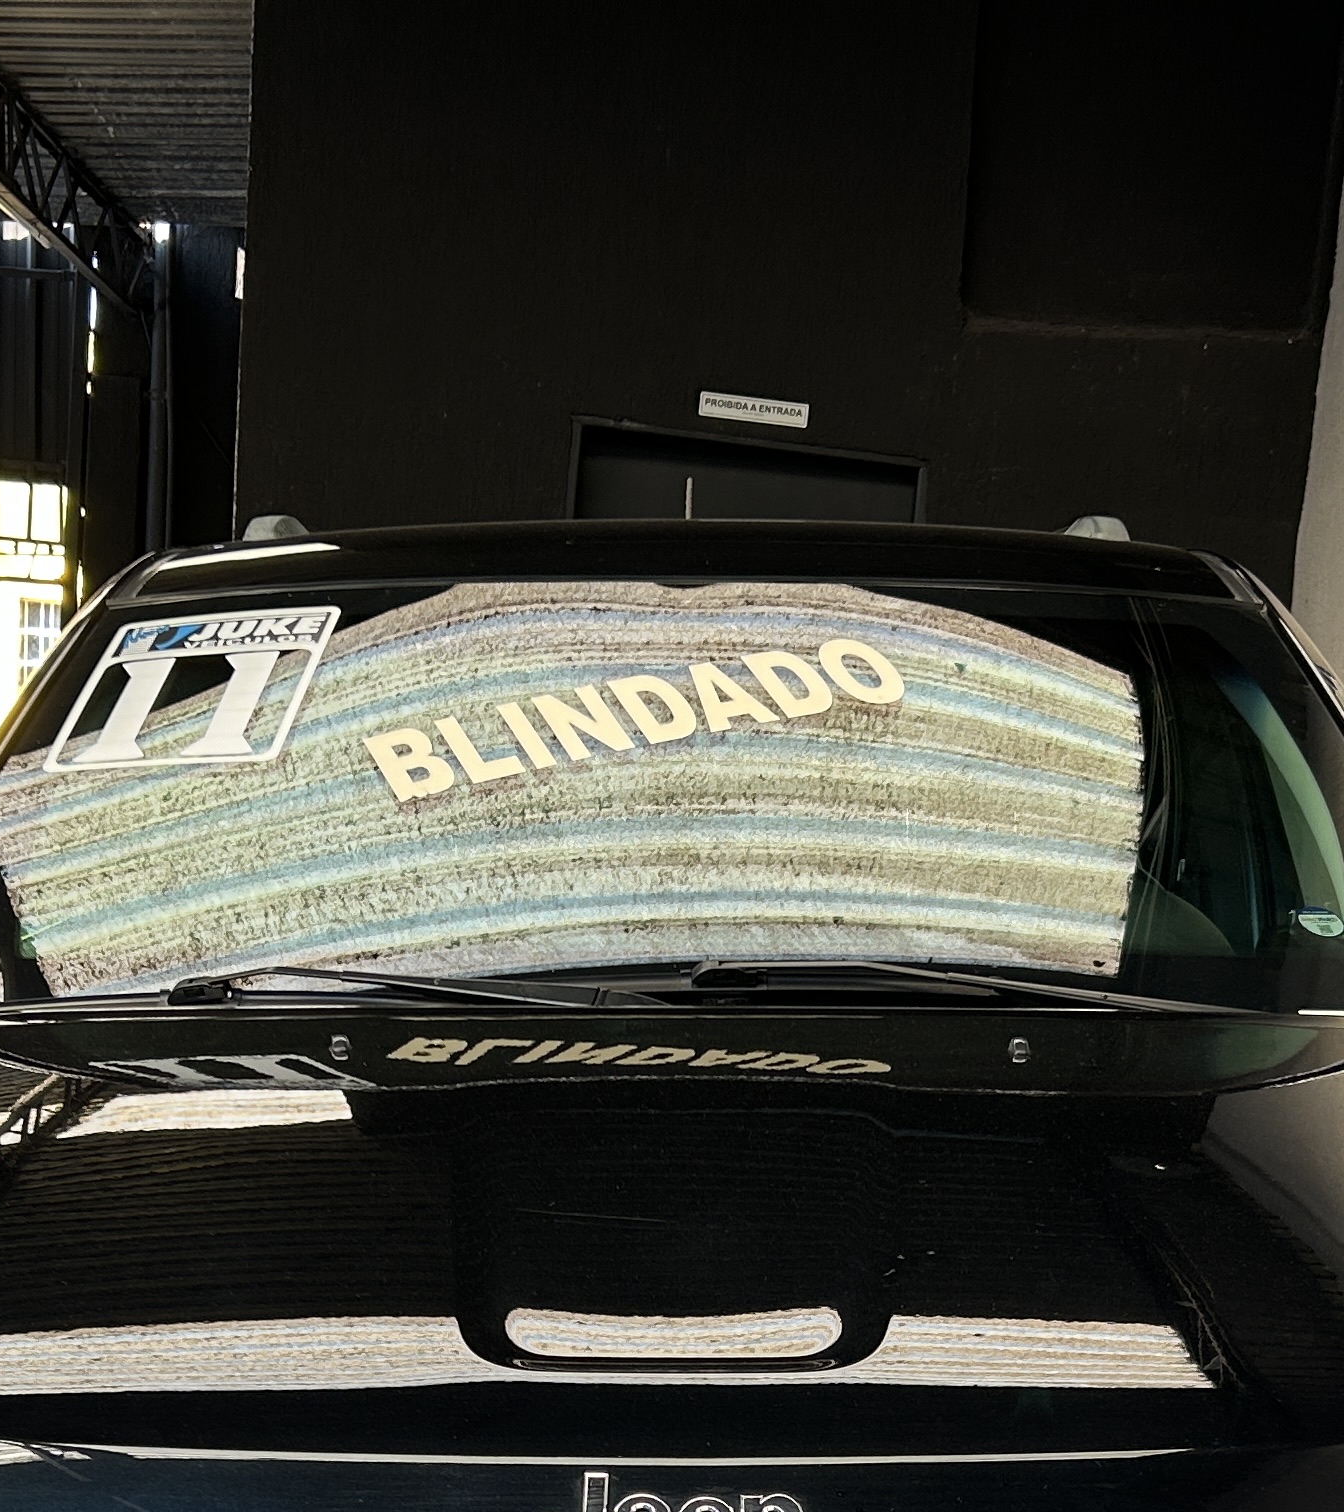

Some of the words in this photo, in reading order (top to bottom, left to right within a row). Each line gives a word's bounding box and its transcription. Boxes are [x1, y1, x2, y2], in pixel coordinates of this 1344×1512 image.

[704, 397, 749, 412] PROIBIDA
[749, 404, 757, 412] A
[758, 404, 803, 418] ENTRADA
[188, 615, 327, 642] JUKE
[363, 638, 906, 803] BLINDADO
